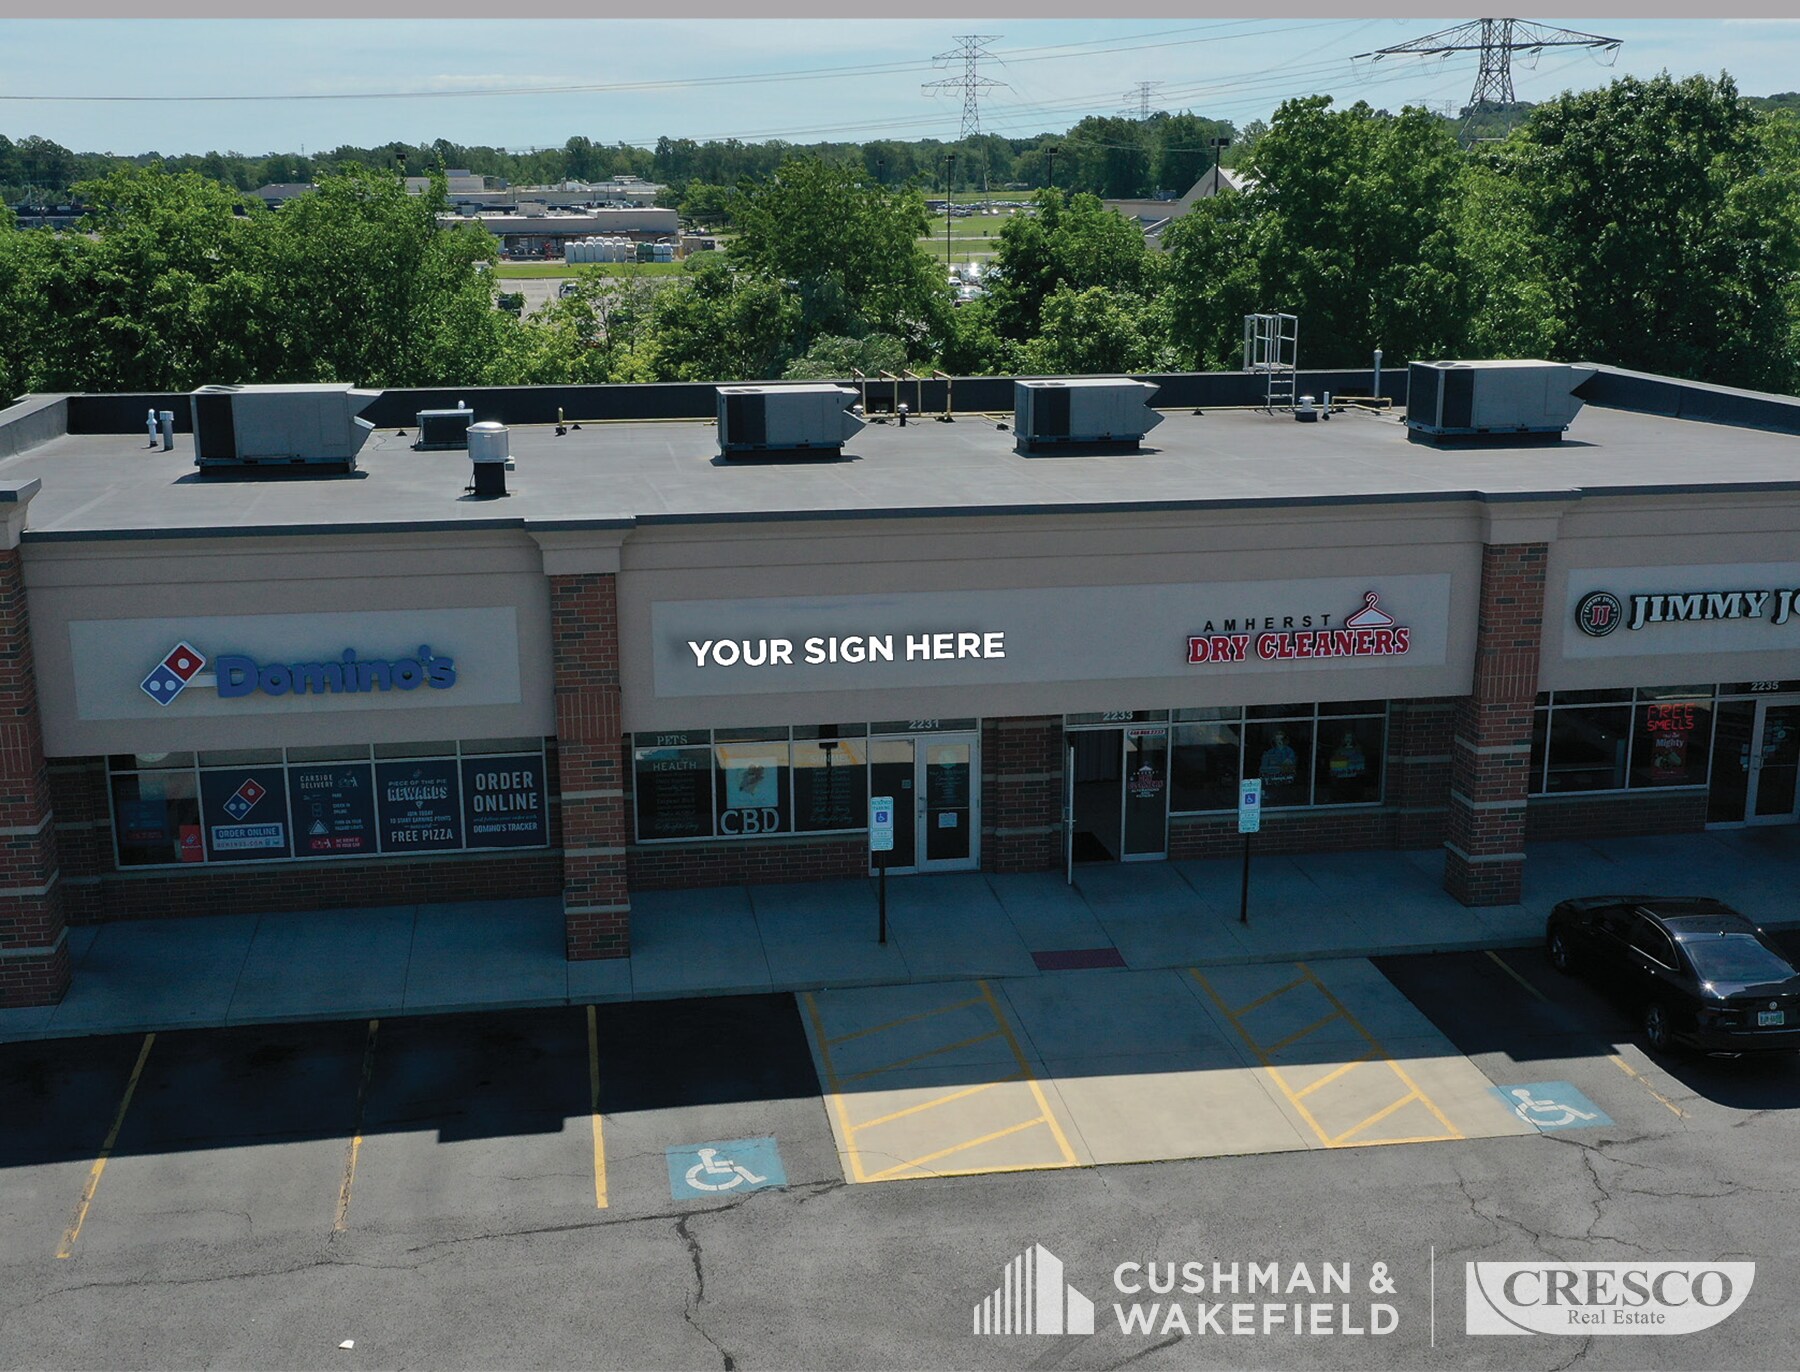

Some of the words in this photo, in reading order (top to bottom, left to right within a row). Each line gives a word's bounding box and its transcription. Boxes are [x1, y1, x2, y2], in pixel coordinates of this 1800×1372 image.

[1627, 590, 1770, 630] JIMMY
[1771, 588, 1800, 625] J
[1203, 614, 1331, 632] AMHERST
[1187, 635, 1250, 664] DRY
[1256, 627, 1410, 661] CLEANERS
[216, 644, 456, 698] Domino's
[1751, 681, 1779, 691] 2235
[1103, 711, 1133, 721] 2233
[1647, 703, 1696, 719] FREE
[909, 720, 939, 730] 2231
[1647, 718, 1695, 732] SMELLS
[656, 735, 688, 745] PETS
[1655, 738, 1685, 748] Mighty
[653, 761, 697, 771] HEALTH
[300, 774, 333, 782] CARSIDE
[300, 781, 334, 789] DELIVERY
[475, 771, 533, 791] ORDER
[387, 786, 449, 802] REWARDS
[473, 791, 538, 812] ONLINE
[473, 823, 507, 833] DOMINO'S
[507, 822, 538, 831] TRACKER
[720, 808, 780, 835] CBD
[218, 828, 247, 839] ORDER
[247, 826, 277, 837] ONLINE
[391, 830, 419, 843] FREE
[422, 828, 453, 841] PIZZA
